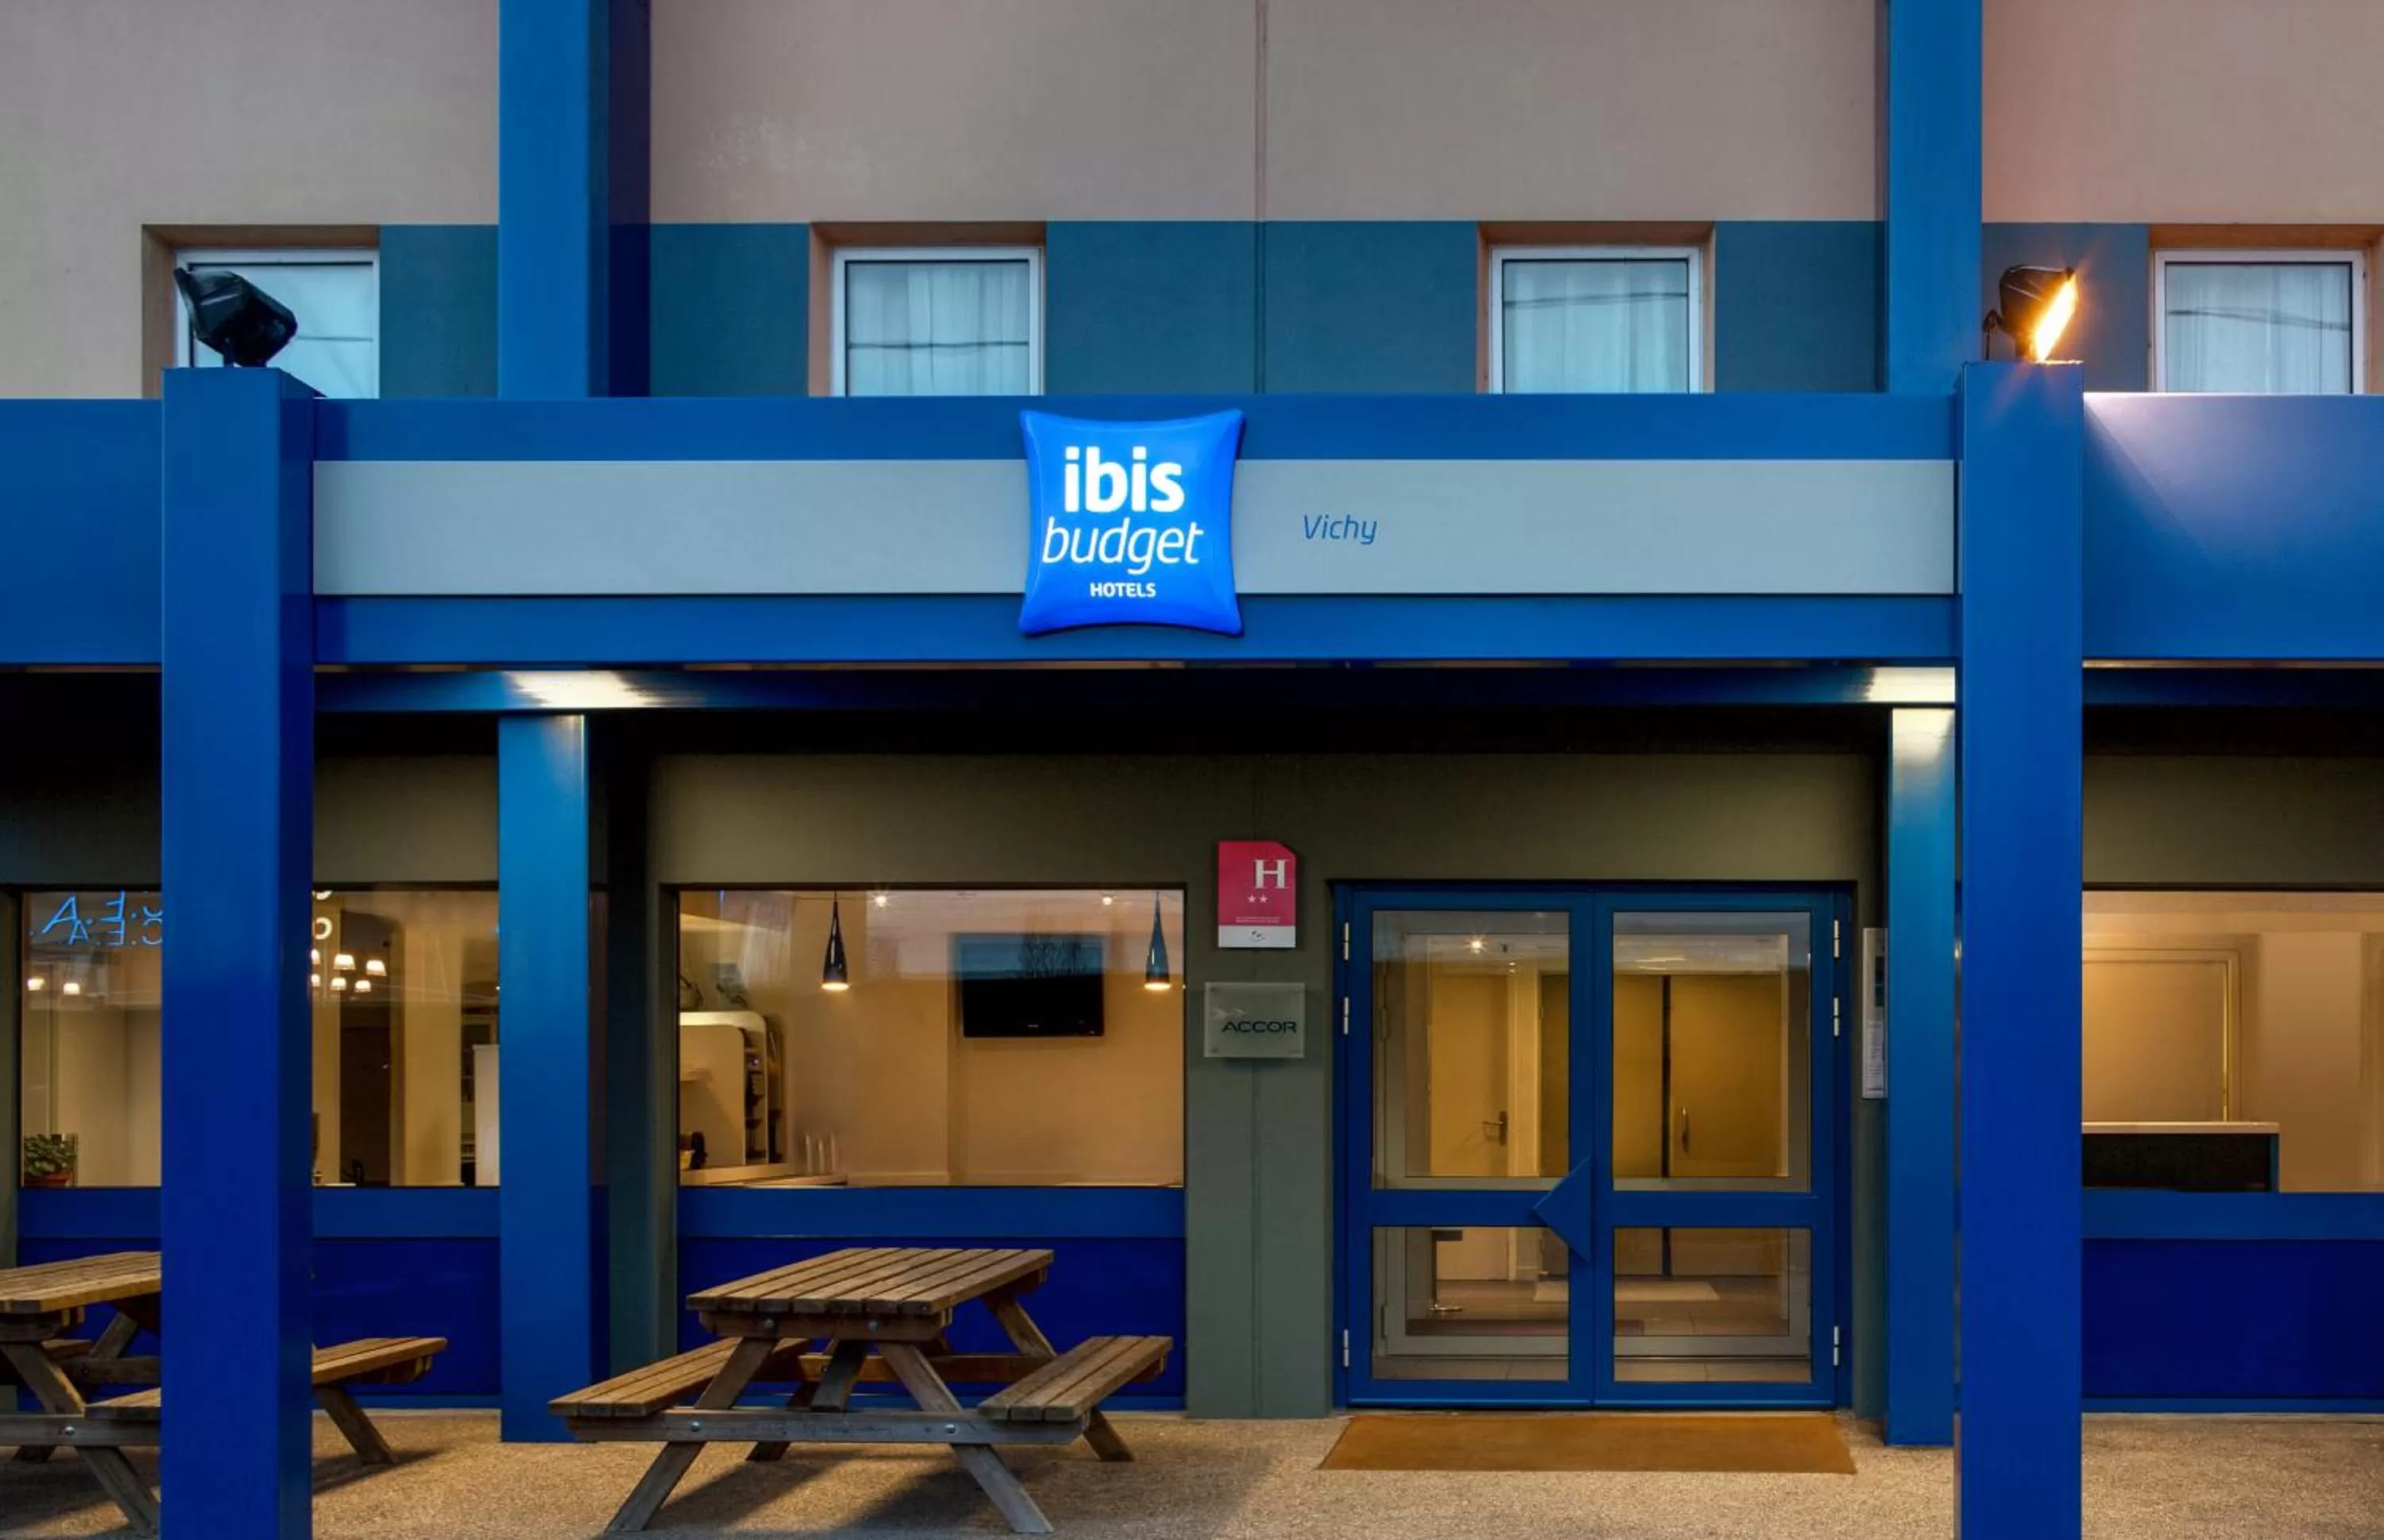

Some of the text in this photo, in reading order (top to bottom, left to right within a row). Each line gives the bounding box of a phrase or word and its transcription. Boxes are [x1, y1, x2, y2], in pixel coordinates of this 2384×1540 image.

[1064, 446, 1185, 513] ibis
[1303, 514, 1378, 544] Vichy
[1042, 517, 1204, 575] budget
[1089, 582, 1156, 598] HOTELS
[1253, 859, 1288, 889] H
[1221, 1020, 1298, 1034] ACCOR
